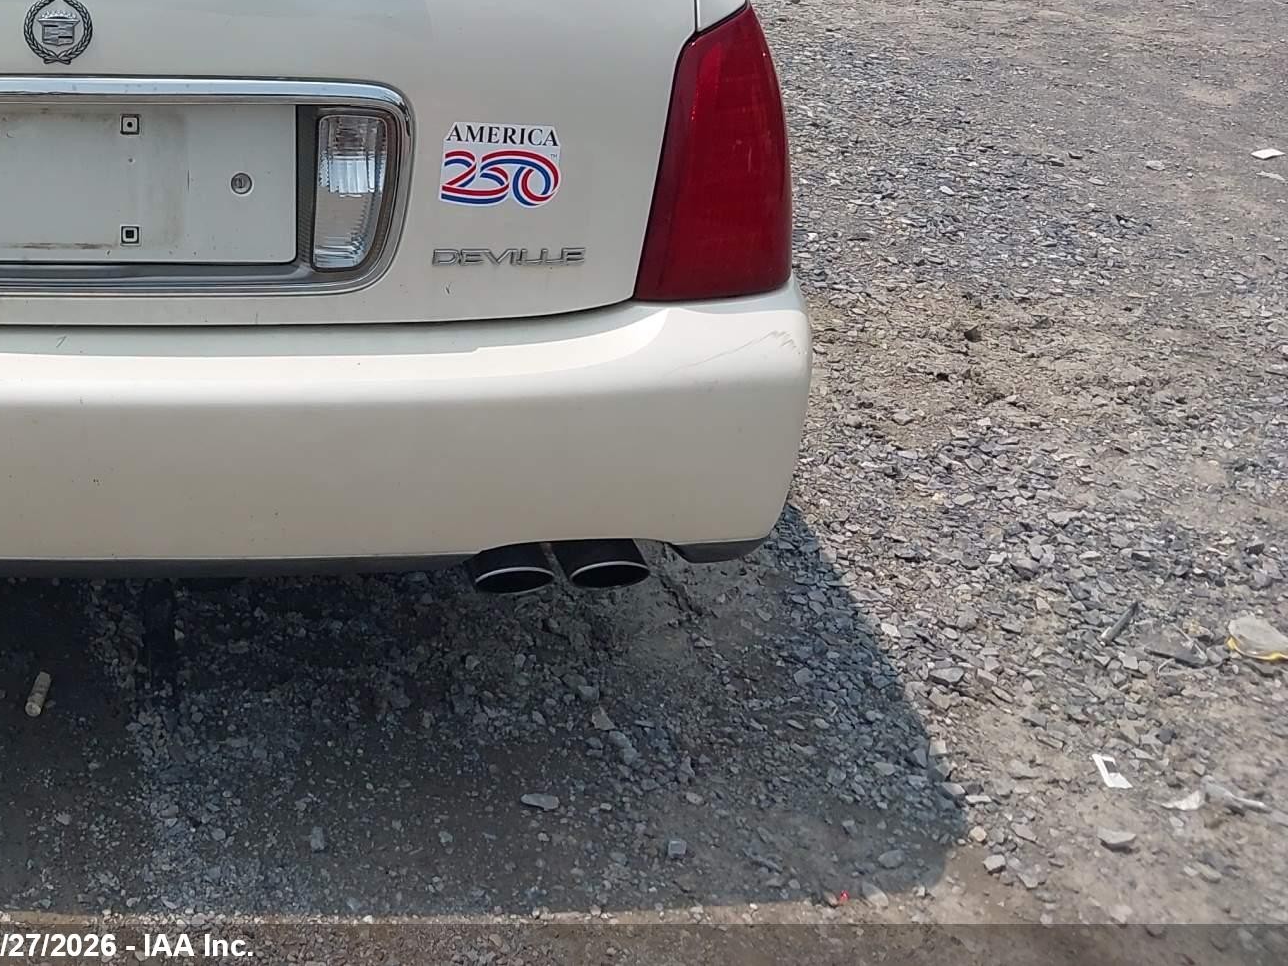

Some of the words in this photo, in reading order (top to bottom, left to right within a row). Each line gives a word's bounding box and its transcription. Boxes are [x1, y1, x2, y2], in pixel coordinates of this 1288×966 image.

[446, 124, 559, 147] AMERICA
[441, 150, 561, 206] 250
[432, 247, 586, 267] DEVILLE
